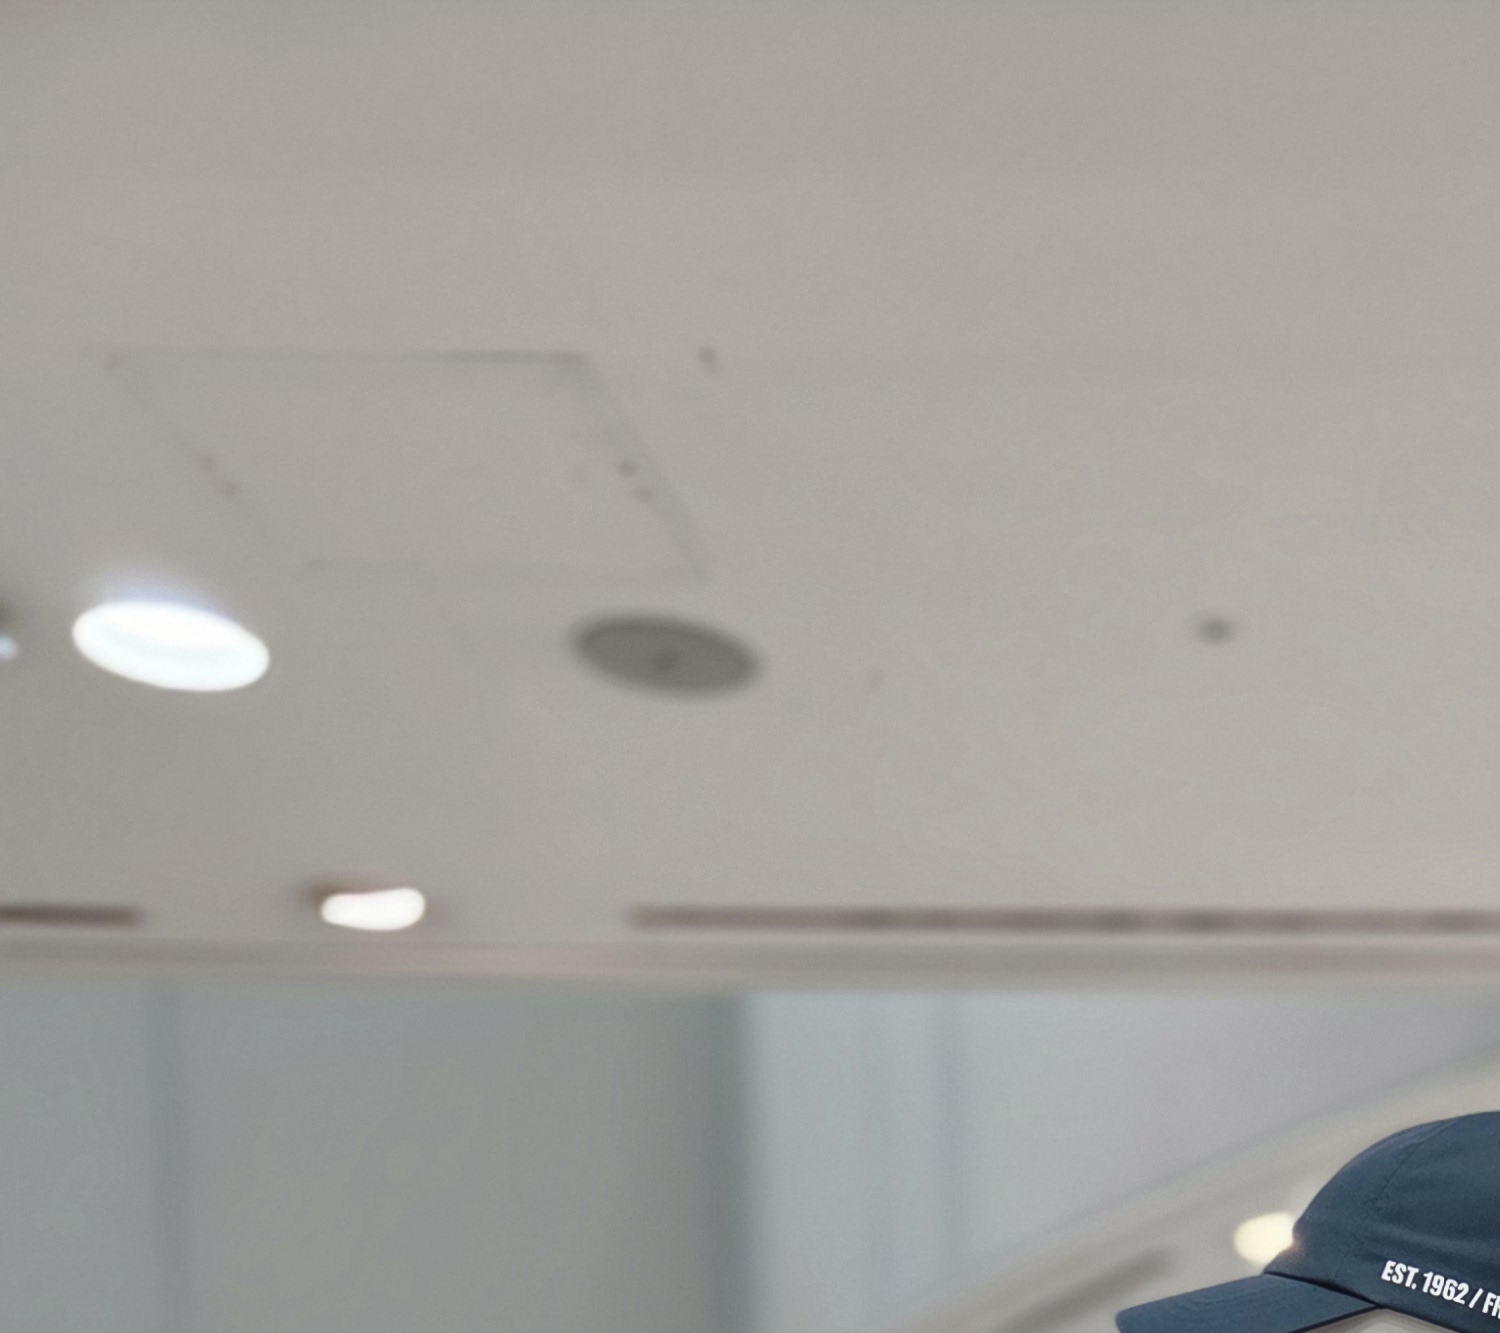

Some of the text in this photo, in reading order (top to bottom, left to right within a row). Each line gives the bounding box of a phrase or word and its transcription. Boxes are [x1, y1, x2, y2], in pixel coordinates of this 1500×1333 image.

[1380, 1260, 1420, 1290] EST.
[1422, 1271, 1470, 1305] 1962
[1468, 1288, 1484, 1309] /
